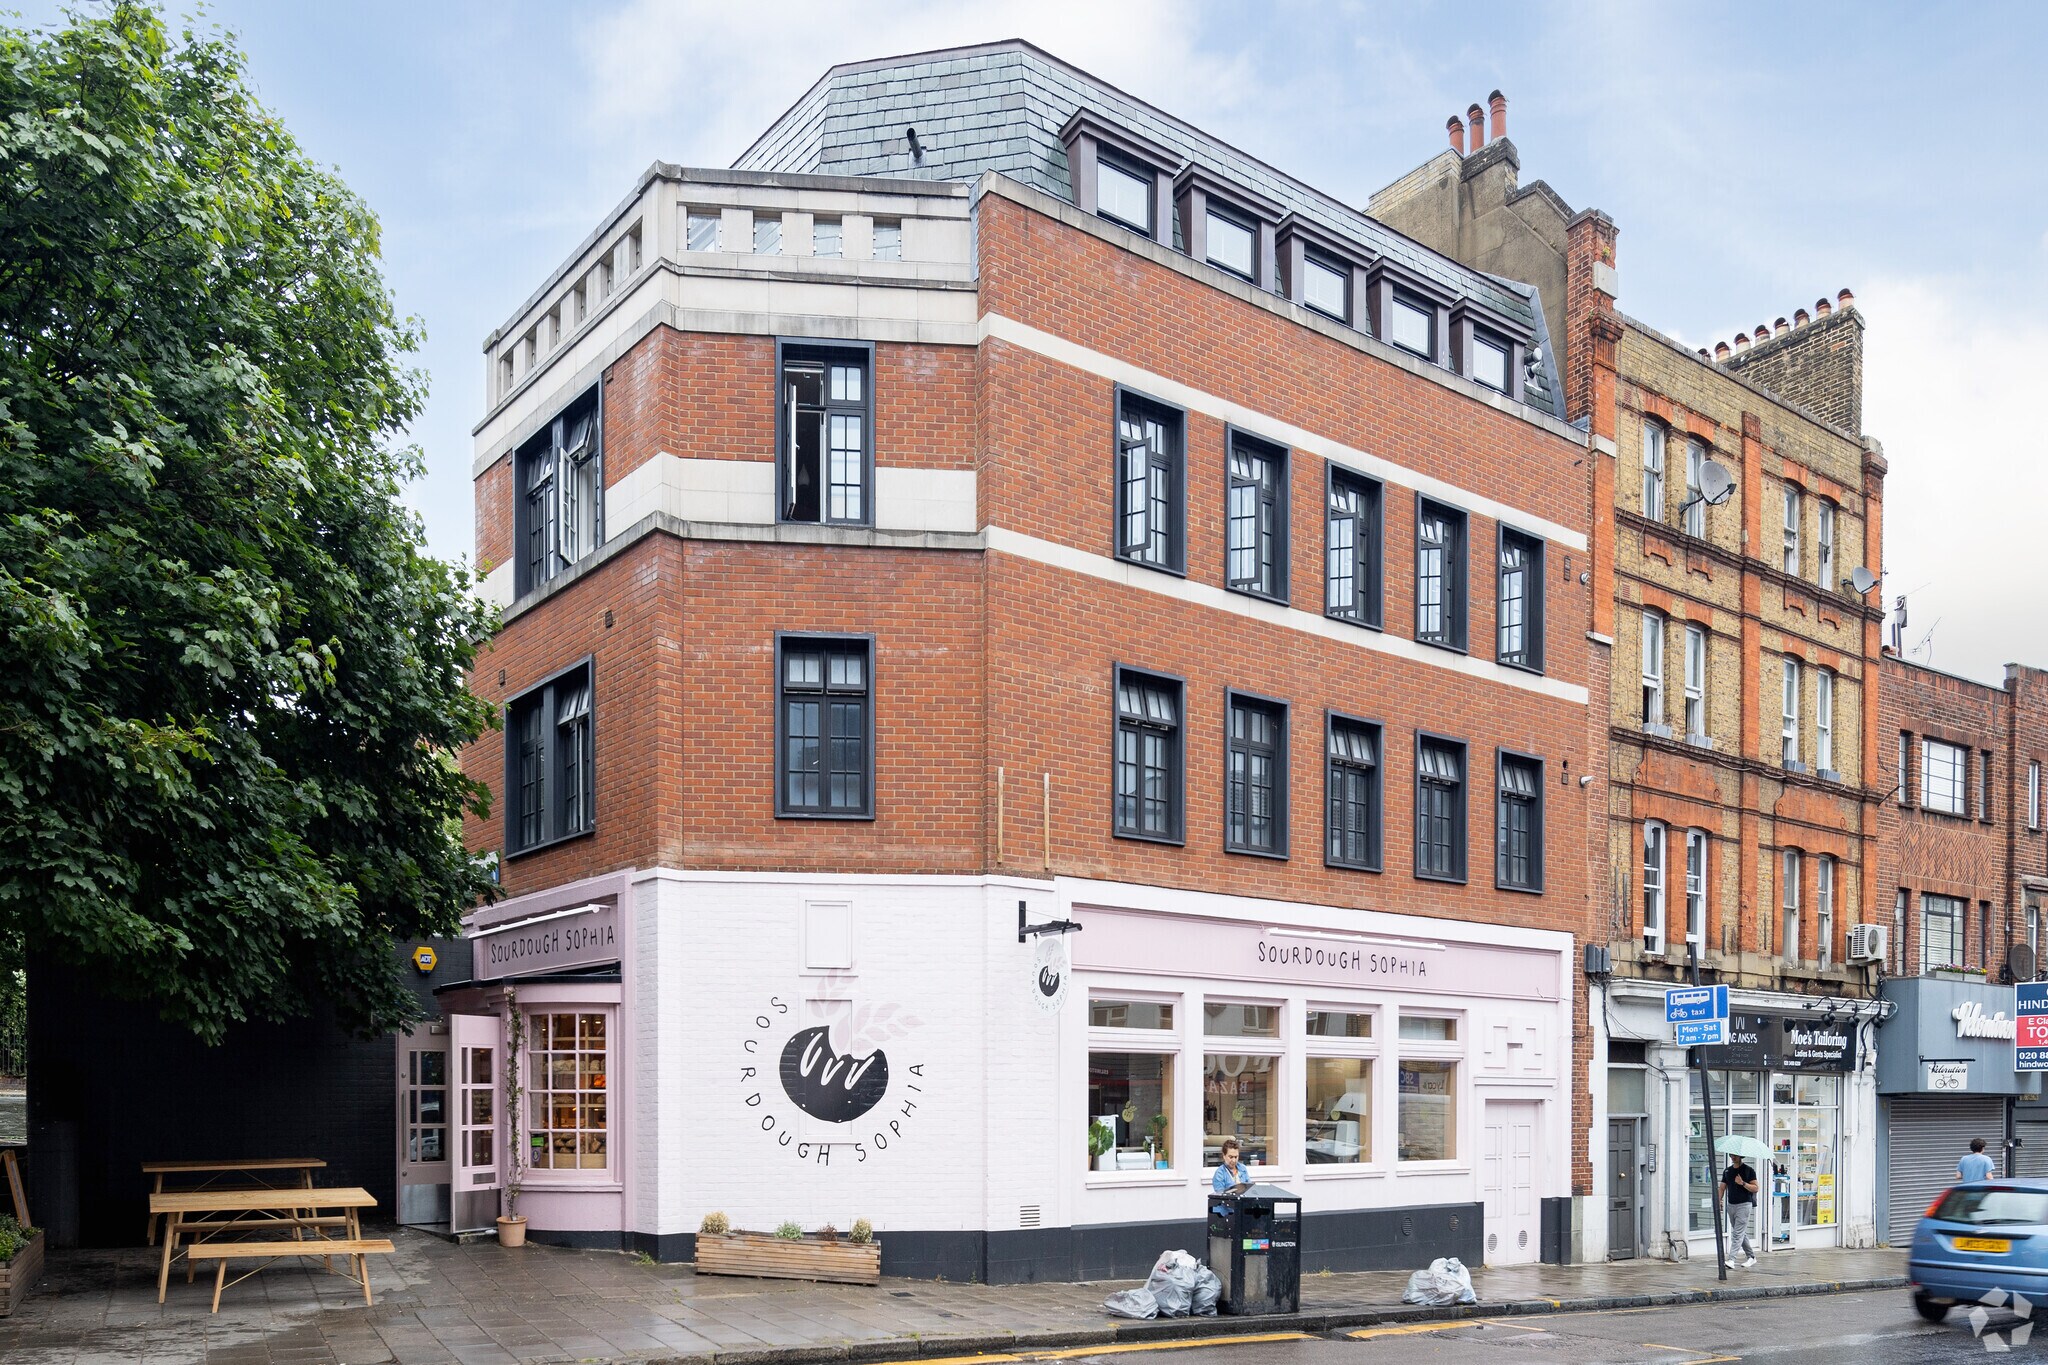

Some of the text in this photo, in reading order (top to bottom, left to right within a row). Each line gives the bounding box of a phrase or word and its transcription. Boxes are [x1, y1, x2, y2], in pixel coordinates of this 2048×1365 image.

[491, 925, 615, 964] SOURDOUGH SOPHIA
[1258, 941, 1427, 977] SOURDOUGH SOPHIA
[1691, 1008, 1706, 1016] taxi
[1790, 1029, 1848, 1050] Moe's Tailoring
[2027, 1026, 2048, 1039] TO
[2019, 1052, 2037, 1060] 020
[1929, 1064, 1967, 1073] Velorution
[741, 997, 924, 1166] SOURDOUGH SOPHIA
